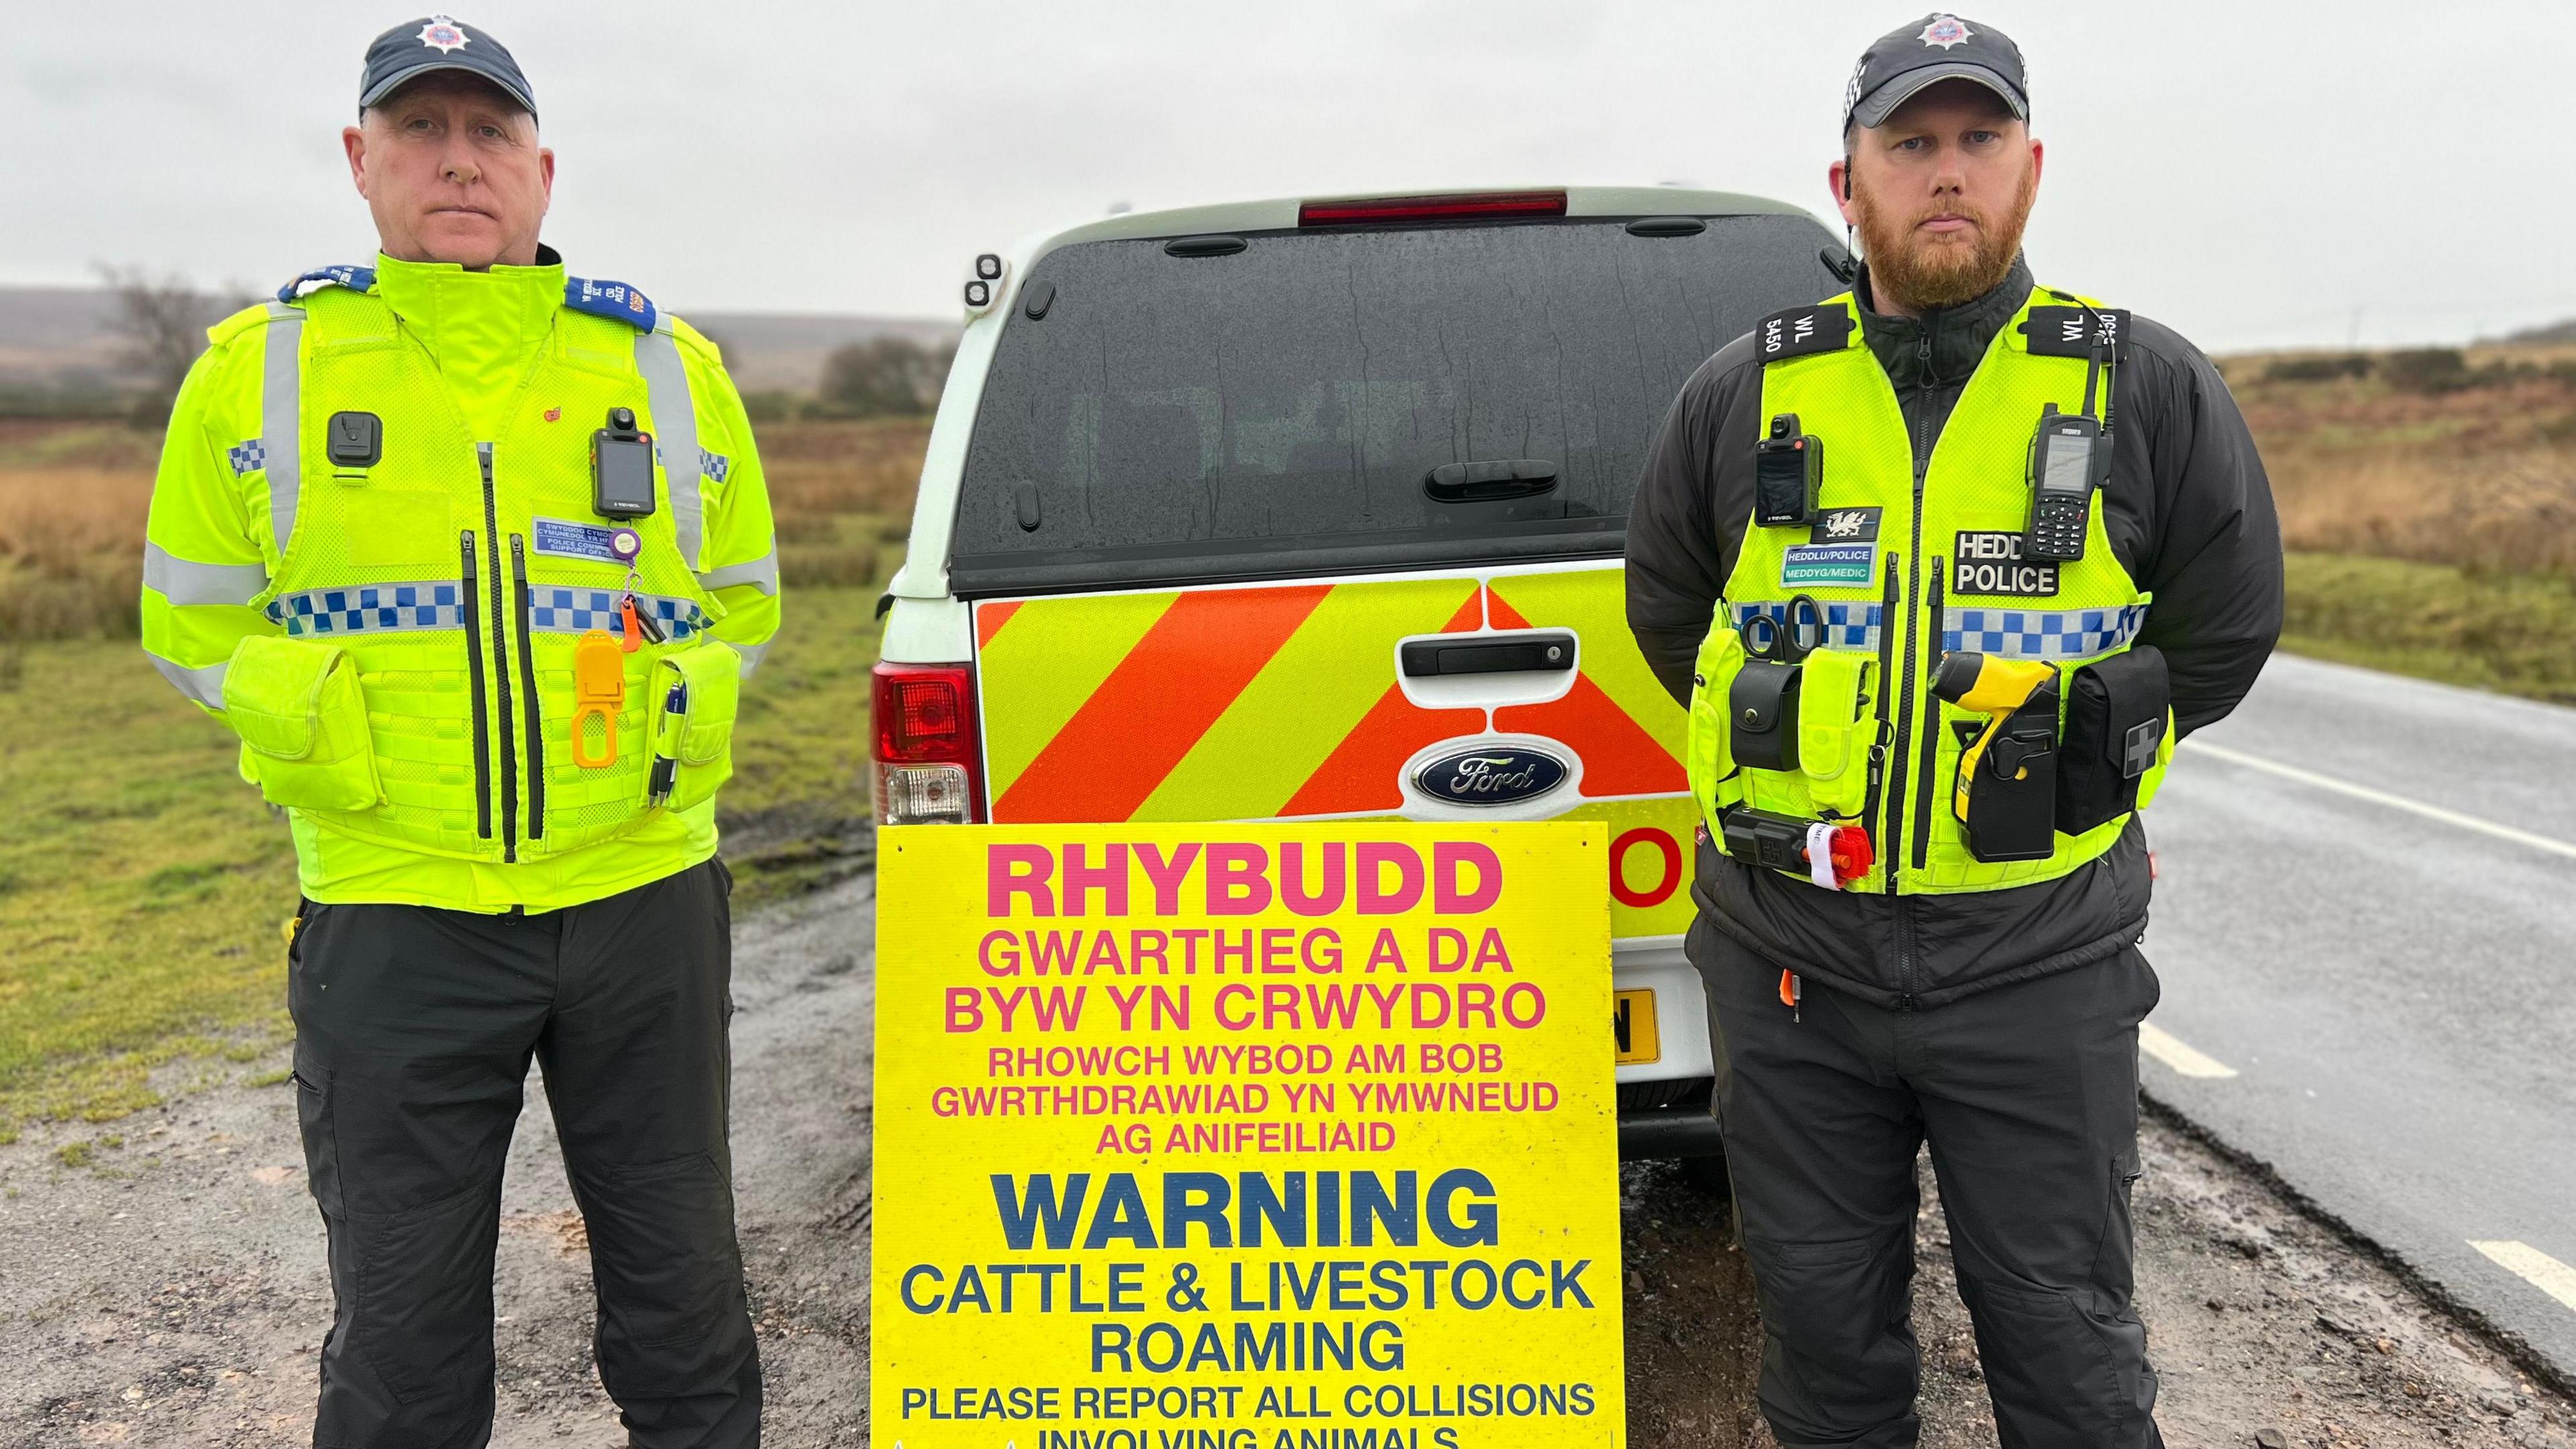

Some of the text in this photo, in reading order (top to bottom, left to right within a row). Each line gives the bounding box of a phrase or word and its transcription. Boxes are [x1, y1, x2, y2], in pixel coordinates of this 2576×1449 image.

[1794, 315, 1813, 343] WL
[2062, 315, 2084, 341] WL
[537, 528, 586, 540] CYMUNEDOL
[545, 523, 612, 538] SWYDDOG CYMO
[547, 538, 576, 547] POLICE
[1958, 533, 2022, 560] HEDD
[550, 544, 612, 557] SUPPORT OFFIC
[1788, 550, 1870, 562] HEDDLU/POLICE
[1785, 568, 1867, 579] MEDDYG/MEDIC
[1957, 564, 2055, 592] POLICE
[1450, 757, 1536, 794] Ford
[987, 842, 1503, 917] RHYBUDD
[978, 927, 1513, 977] GWARTHEG A DA
[945, 981, 1546, 1033] BYW YN CRWYDRO
[989, 1043, 1503, 1077] RHOWCH WYBOD AM BOB
[932, 1082, 1558, 1117] GWRTHDRAWIAD YN YMWNEUD
[1096, 1122, 1395, 1155] AG ANIFEILIAID
[990, 1168, 1498, 1250] WARNING
[900, 1259, 1595, 1314] CATTLE & LIVESTOCK
[1091, 1320, 1404, 1373] ROAMING
[903, 1383, 1595, 1419] PLEASE REPORT ALL COLLISIONS
